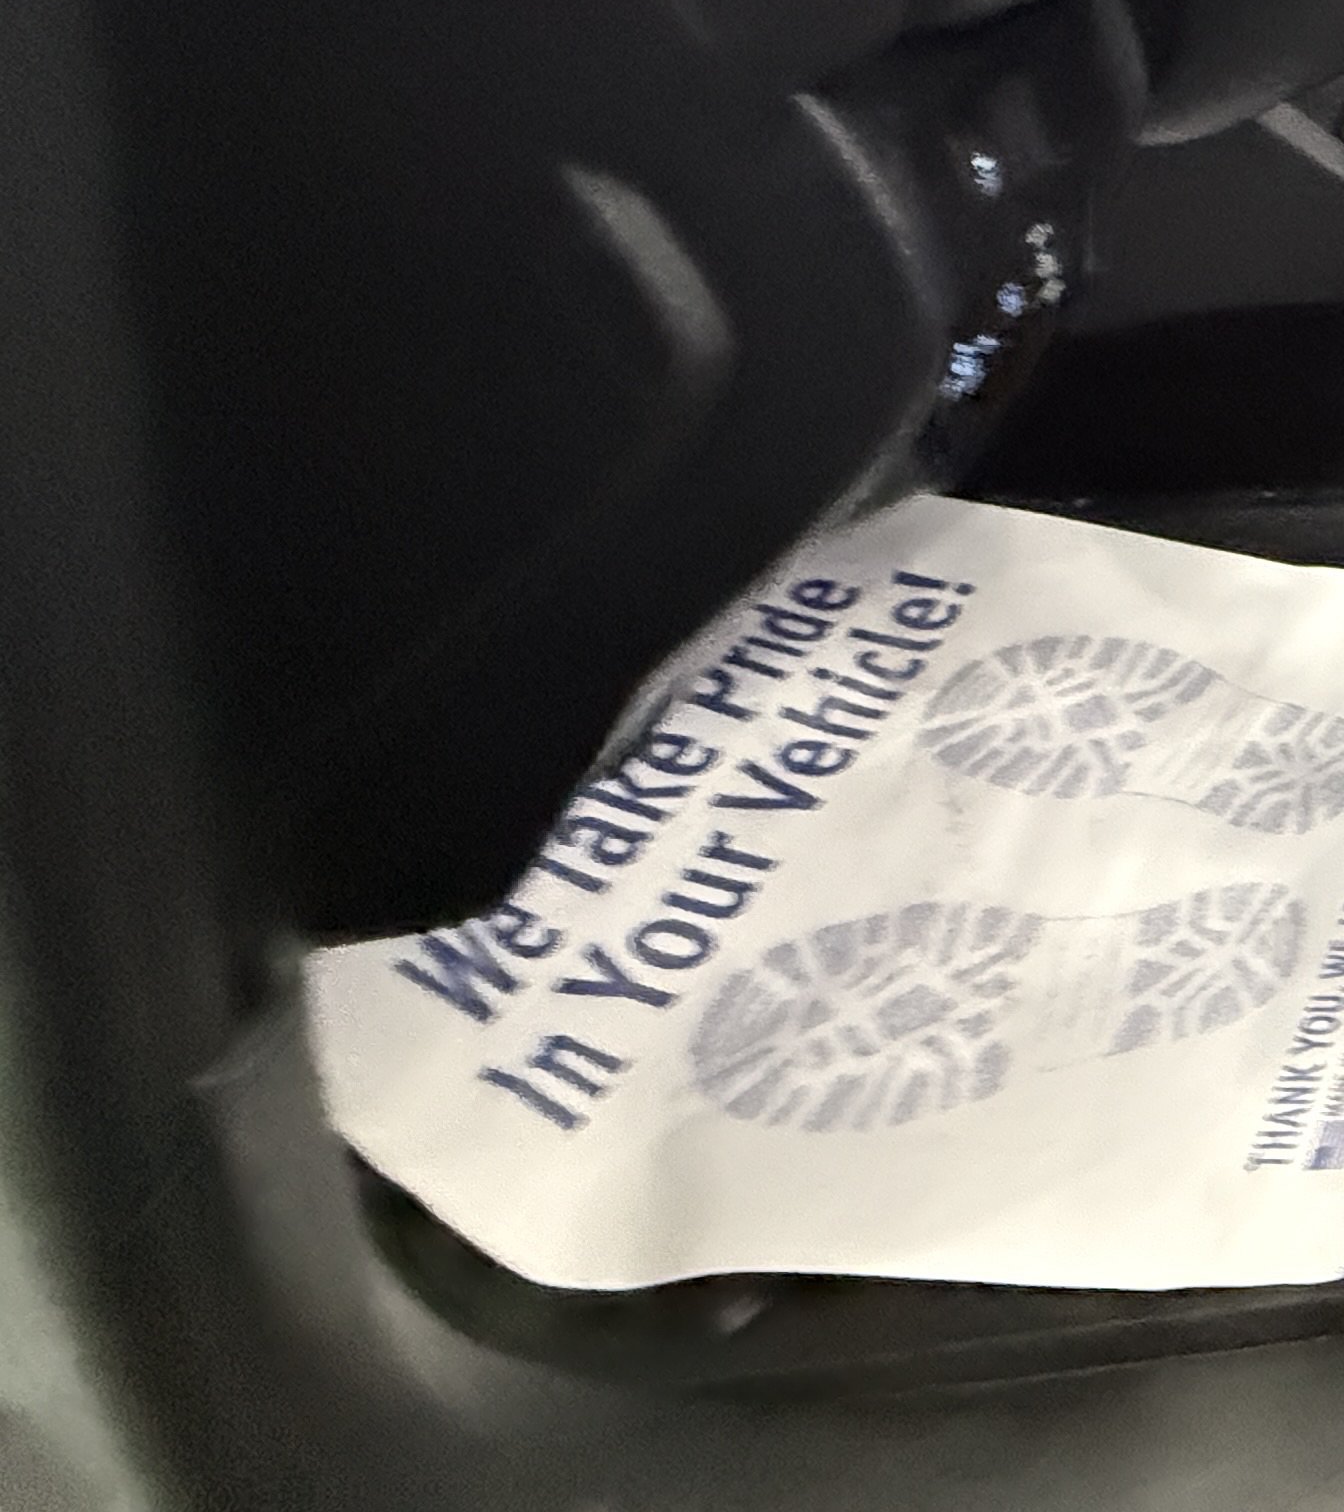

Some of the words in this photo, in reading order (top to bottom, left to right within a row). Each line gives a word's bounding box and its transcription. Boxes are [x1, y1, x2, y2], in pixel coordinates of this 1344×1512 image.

[709, 570, 976, 810] Vehicle!
[394, 904, 563, 1023] We
[552, 830, 779, 1008] Your
[479, 1035, 631, 1130] In
[1244, 1061, 1327, 1171] THANK
